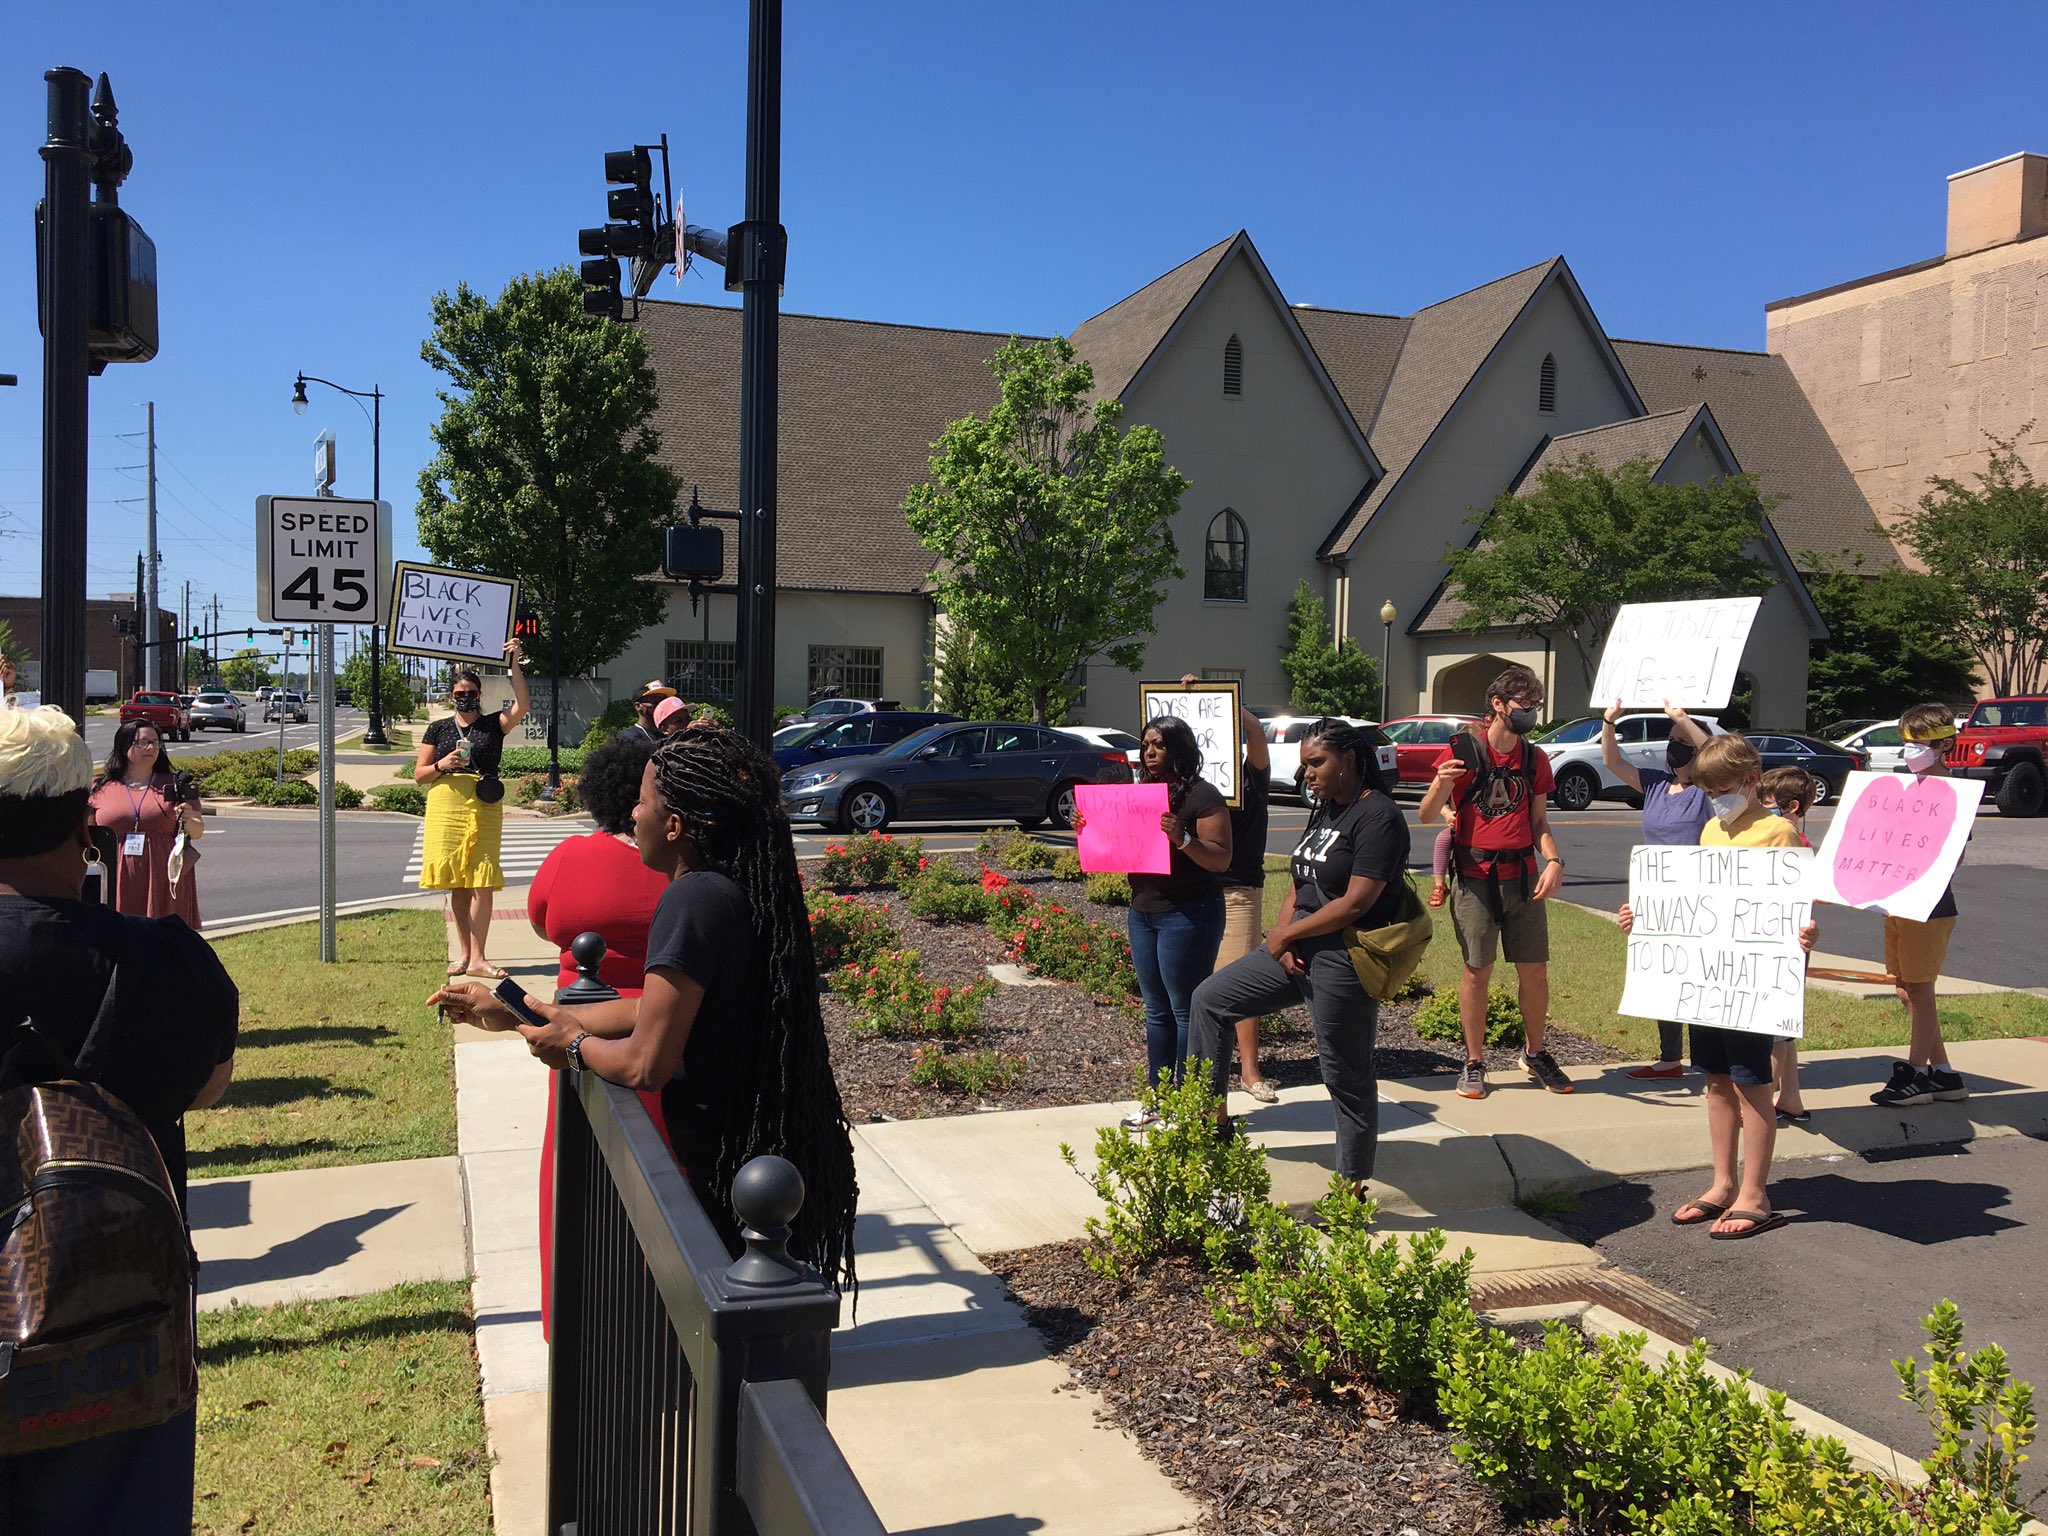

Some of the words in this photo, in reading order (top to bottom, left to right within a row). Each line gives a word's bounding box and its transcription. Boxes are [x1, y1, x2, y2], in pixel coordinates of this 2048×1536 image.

[281, 512, 369, 533] SPEED
[291, 538, 359, 558] LIMIT
[281, 566, 369, 612] 45
[404, 573, 482, 607] BLACK
[401, 601, 471, 630] LIVES
[398, 621, 485, 650] MATTER
[1592, 658, 1627, 702] NO
[1147, 696, 1190, 720] DOGS
[1198, 696, 1223, 719] ARE
[1868, 795, 1941, 817] BLACK
[1858, 827, 1930, 848] LIVES
[1690, 848, 1753, 886] TIME
[1766, 850, 1801, 886] IS
[1838, 857, 1919, 881] MATTER
[1633, 894, 1718, 936] ALWAYS
[1731, 898, 1809, 938] RIGHT
[1628, 941, 1653, 972] TO
[1662, 942, 1689, 975] DO
[1699, 947, 1764, 988] WHAT
[1772, 956, 1801, 996] IS
